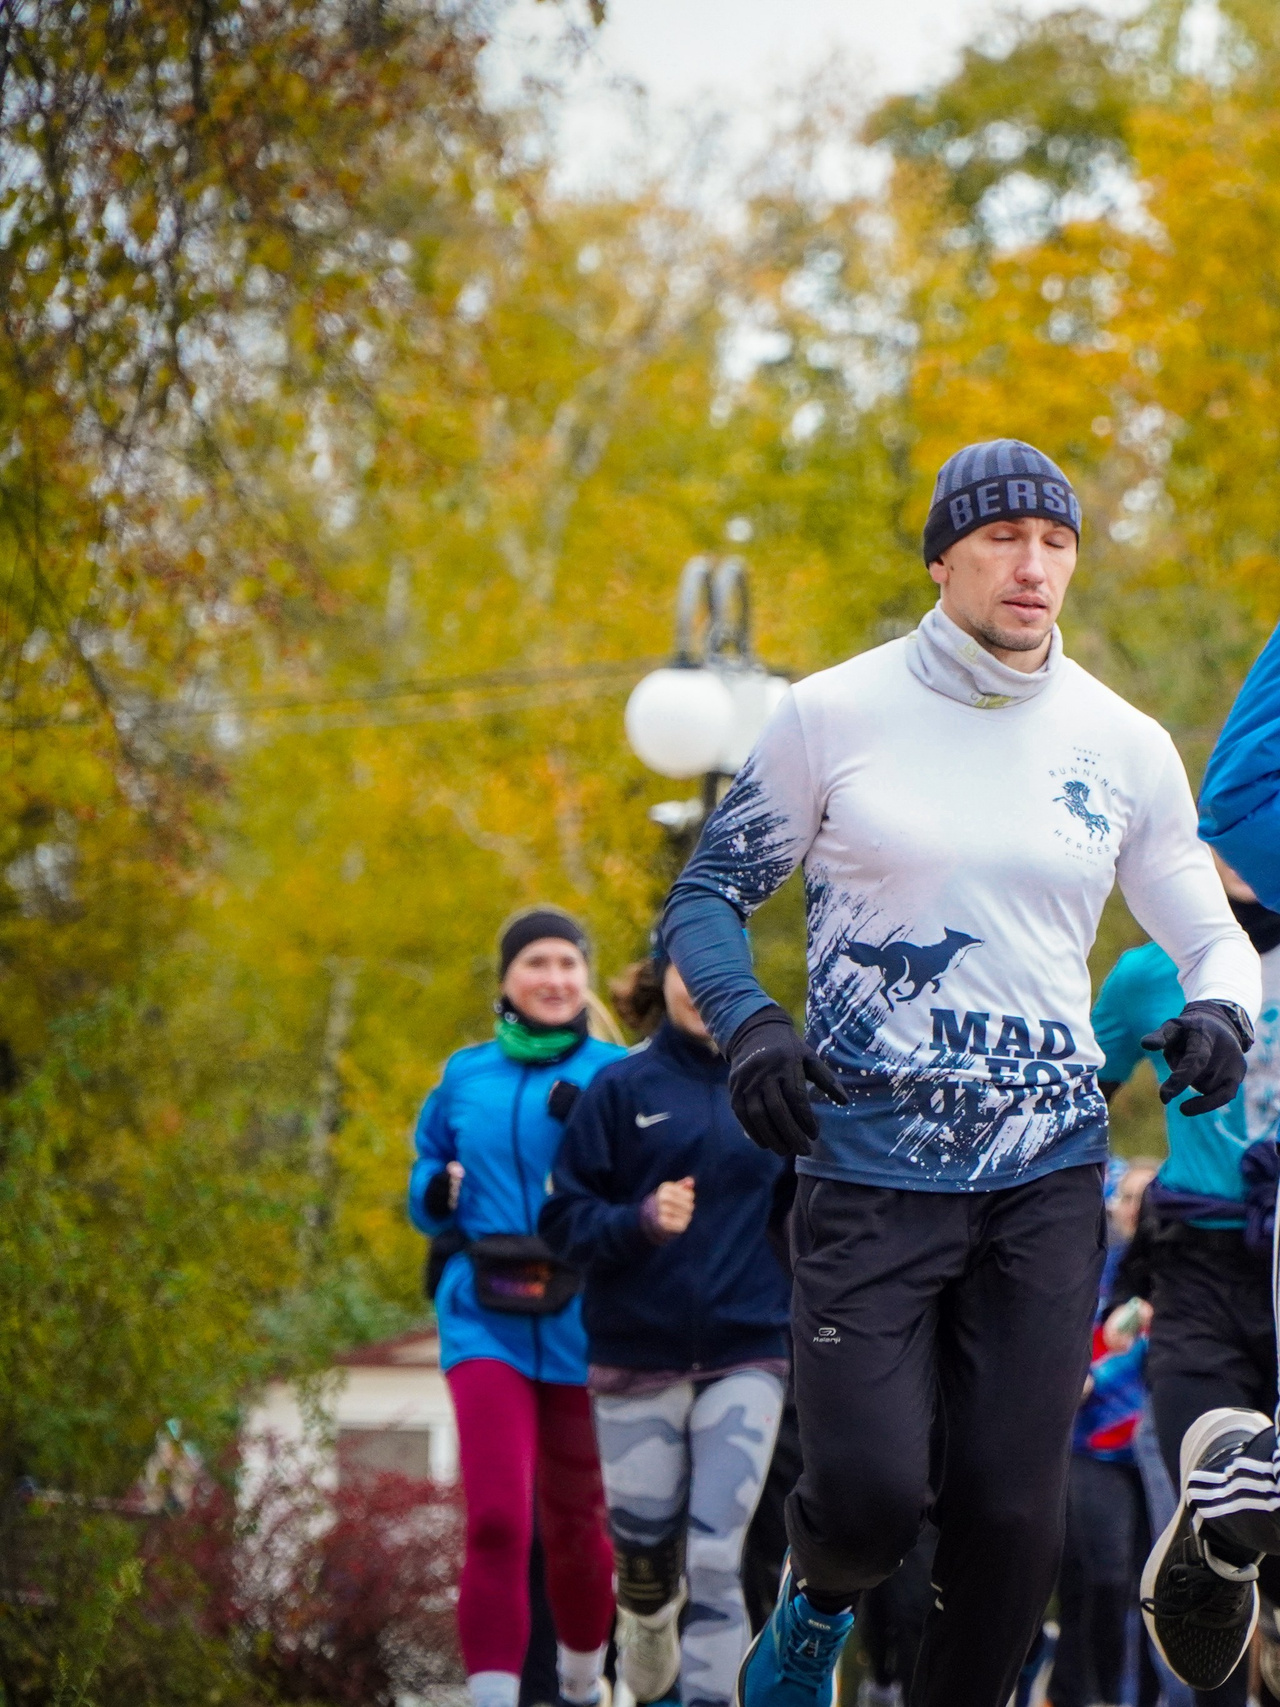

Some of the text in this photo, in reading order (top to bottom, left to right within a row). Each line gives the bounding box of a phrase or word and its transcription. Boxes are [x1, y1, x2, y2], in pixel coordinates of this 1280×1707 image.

[1048, 766, 1118, 797] RUNNING
[1054, 829, 1111, 855] HEROES
[929, 1008, 1077, 1061] MAD
